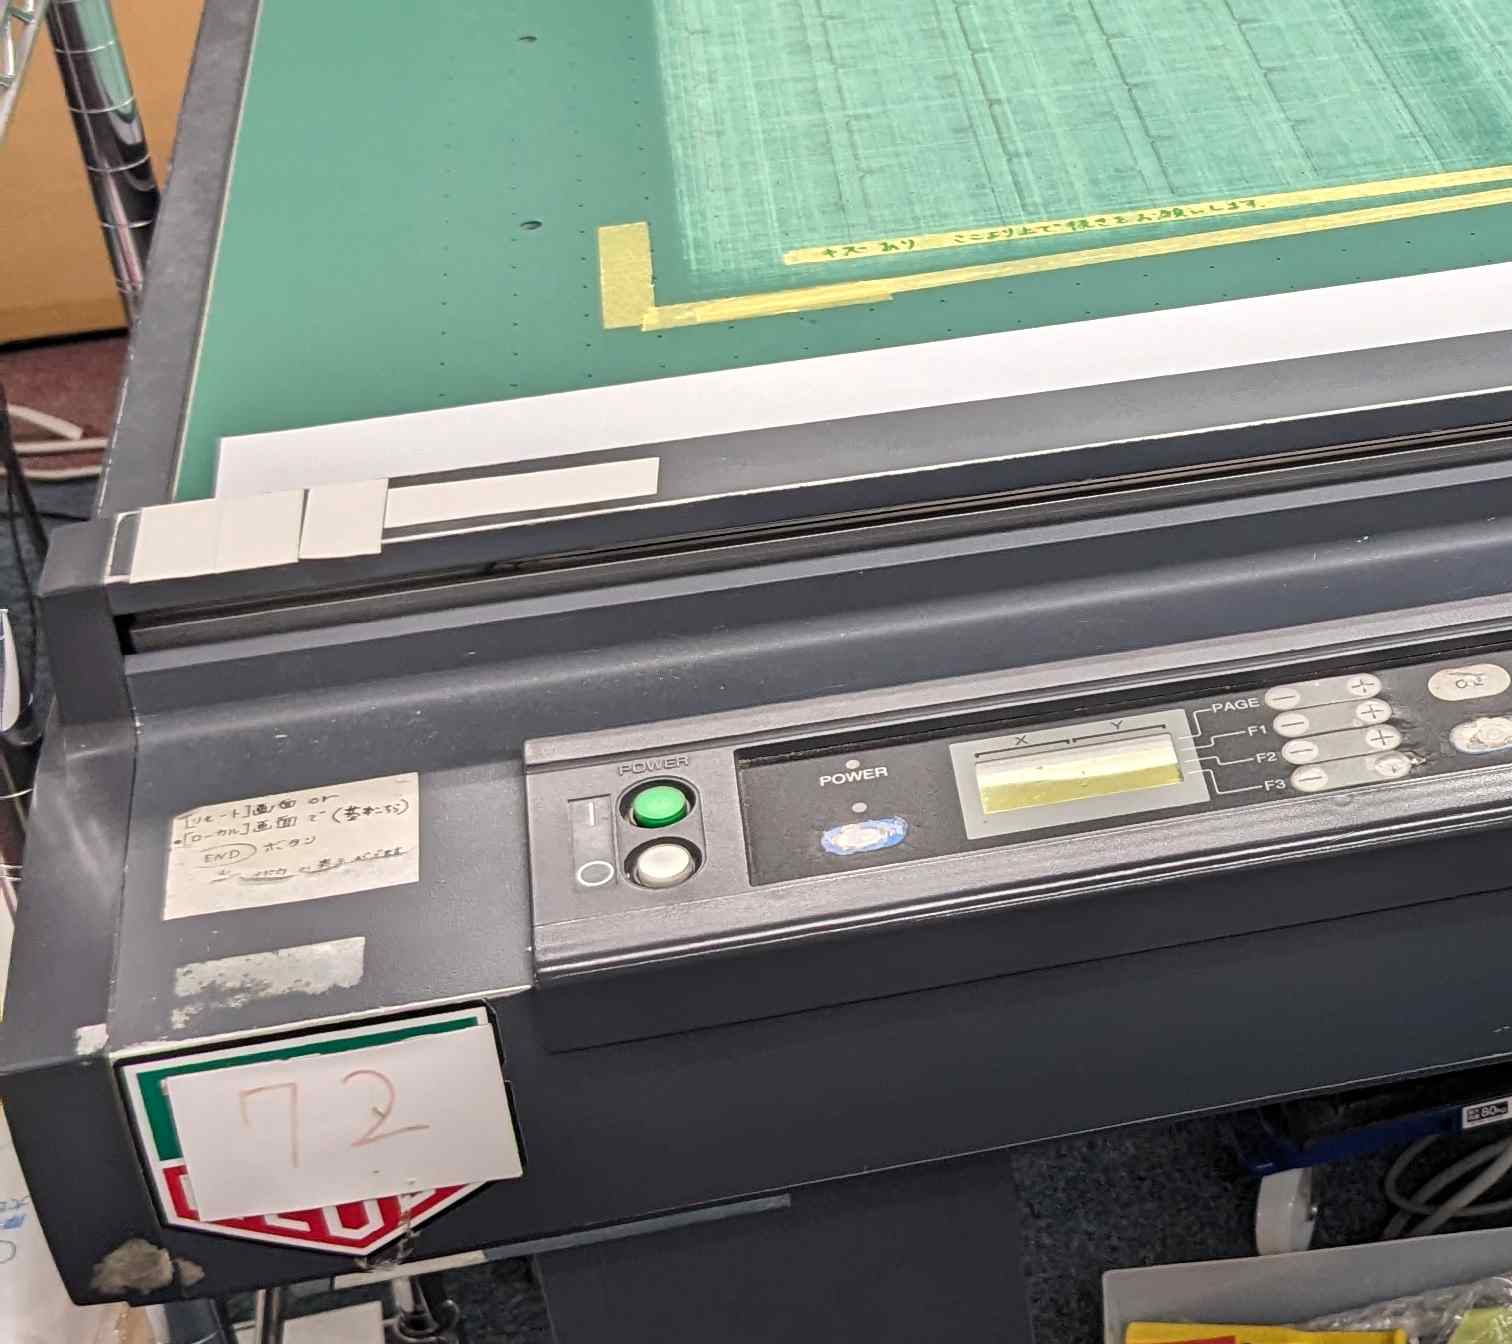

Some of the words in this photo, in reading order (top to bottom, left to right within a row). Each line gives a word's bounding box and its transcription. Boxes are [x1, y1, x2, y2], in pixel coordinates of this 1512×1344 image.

[1211, 696, 1261, 714] PAGE
[1111, 720, 1124, 731] Y
[1247, 723, 1268, 737] F1
[1014, 735, 1029, 746] X
[1255, 750, 1277, 765] F2
[617, 754, 690, 777] POWER
[818, 765, 889, 787] POWER
[1263, 778, 1287, 792] F3
[203, 848, 243, 864] END
